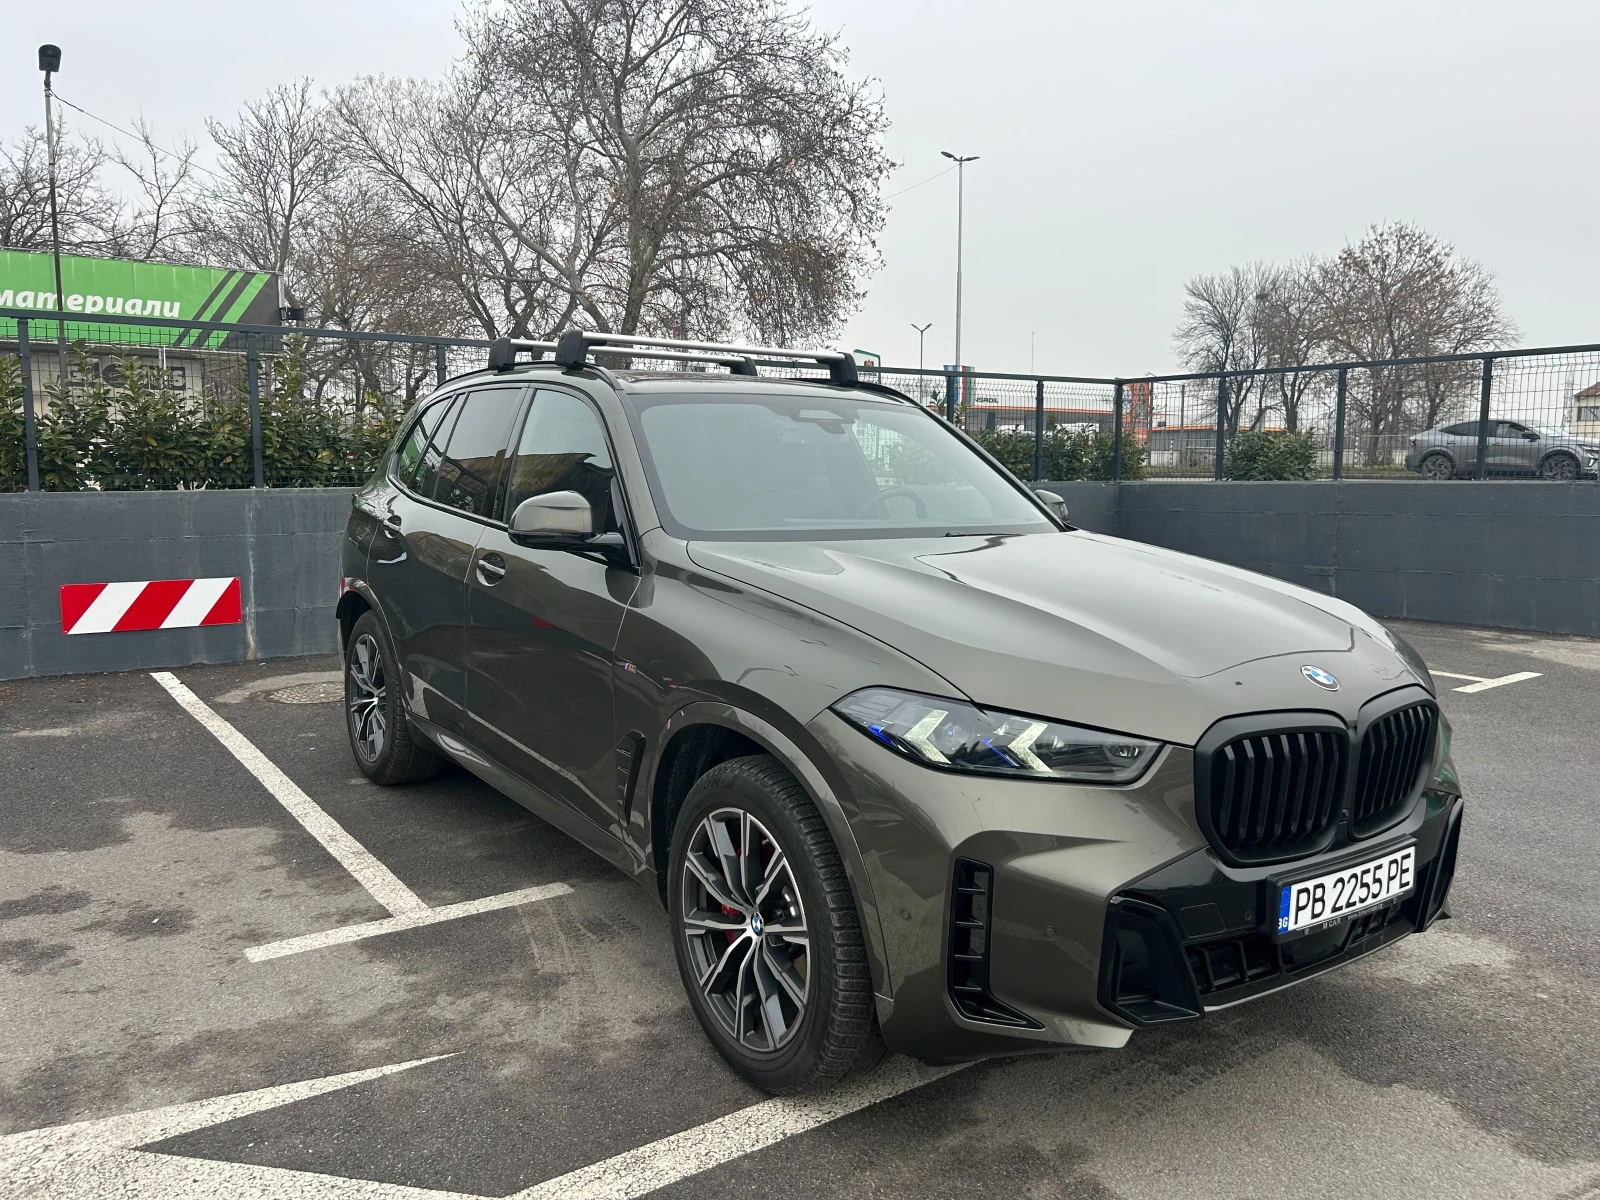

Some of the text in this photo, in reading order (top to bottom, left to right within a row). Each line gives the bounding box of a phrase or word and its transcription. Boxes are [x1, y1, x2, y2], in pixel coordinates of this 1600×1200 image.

[1294, 852, 1412, 925] PB 2255 PE
